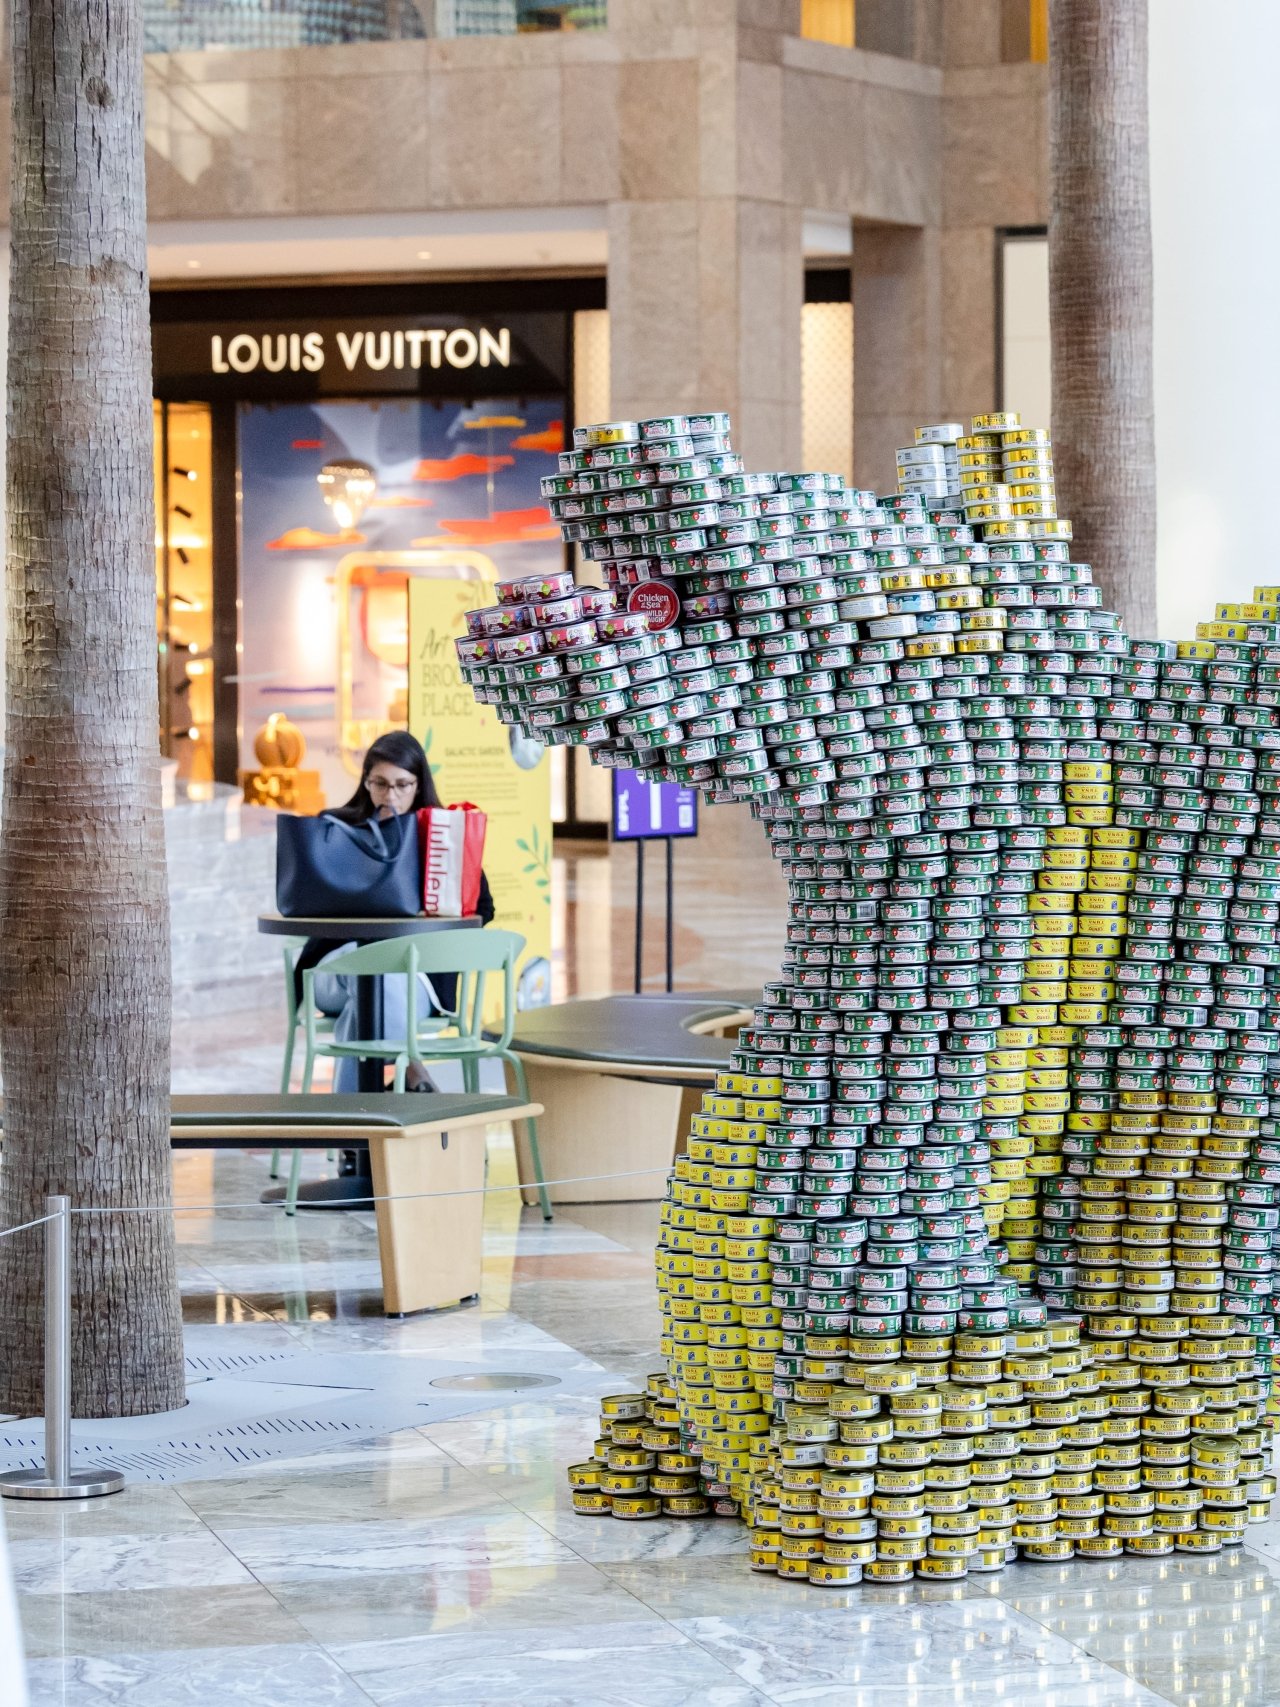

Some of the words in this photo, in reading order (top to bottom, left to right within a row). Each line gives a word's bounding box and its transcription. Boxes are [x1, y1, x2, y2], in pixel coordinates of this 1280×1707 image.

[211, 331, 325, 373] LOUIS
[336, 327, 510, 370] VUITTON
[637, 594, 669, 602] Chicken
[421, 628, 449, 659] Art
[421, 692, 473, 717] PLACE
